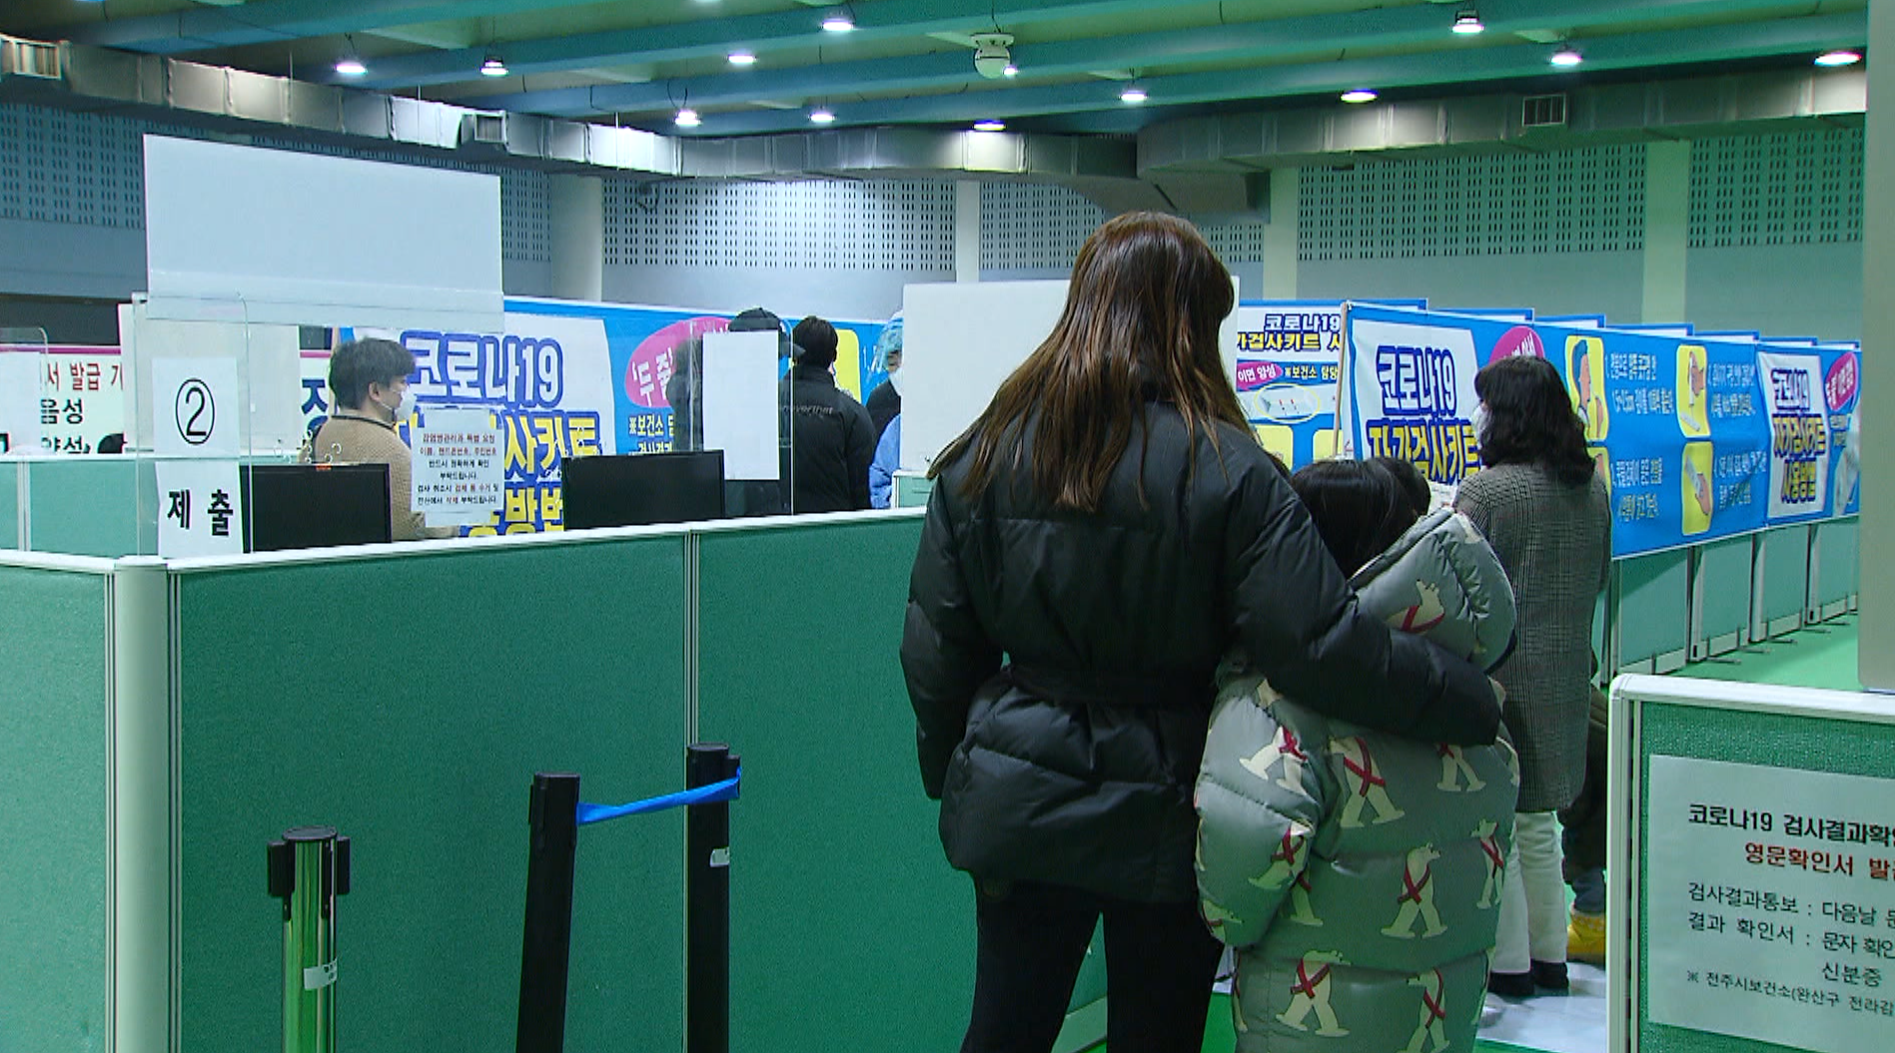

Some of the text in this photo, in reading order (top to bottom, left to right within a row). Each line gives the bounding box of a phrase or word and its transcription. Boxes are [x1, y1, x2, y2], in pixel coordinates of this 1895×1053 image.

[1265, 313, 1341, 332] 코로나19
[69, 361, 101, 391] 발급
[402, 332, 563, 406] 코로나19
[1376, 346, 1458, 415] 코로나19
[1367, 420, 1480, 484] 자가검사키트
[167, 488, 234, 537] 제 출
[1688, 803, 1895, 848] 코로나19 검사결과확
[1745, 842, 1895, 882] 영문확인서 발
[1688, 881, 1799, 914] 검사결과통보
[1821, 901, 1877, 927] 다음날
[1688, 911, 1726, 934] 결과
[1736, 918, 1795, 945] 확인서
[1822, 932, 1858, 954] 문자
[1821, 962, 1882, 988] 신분증
